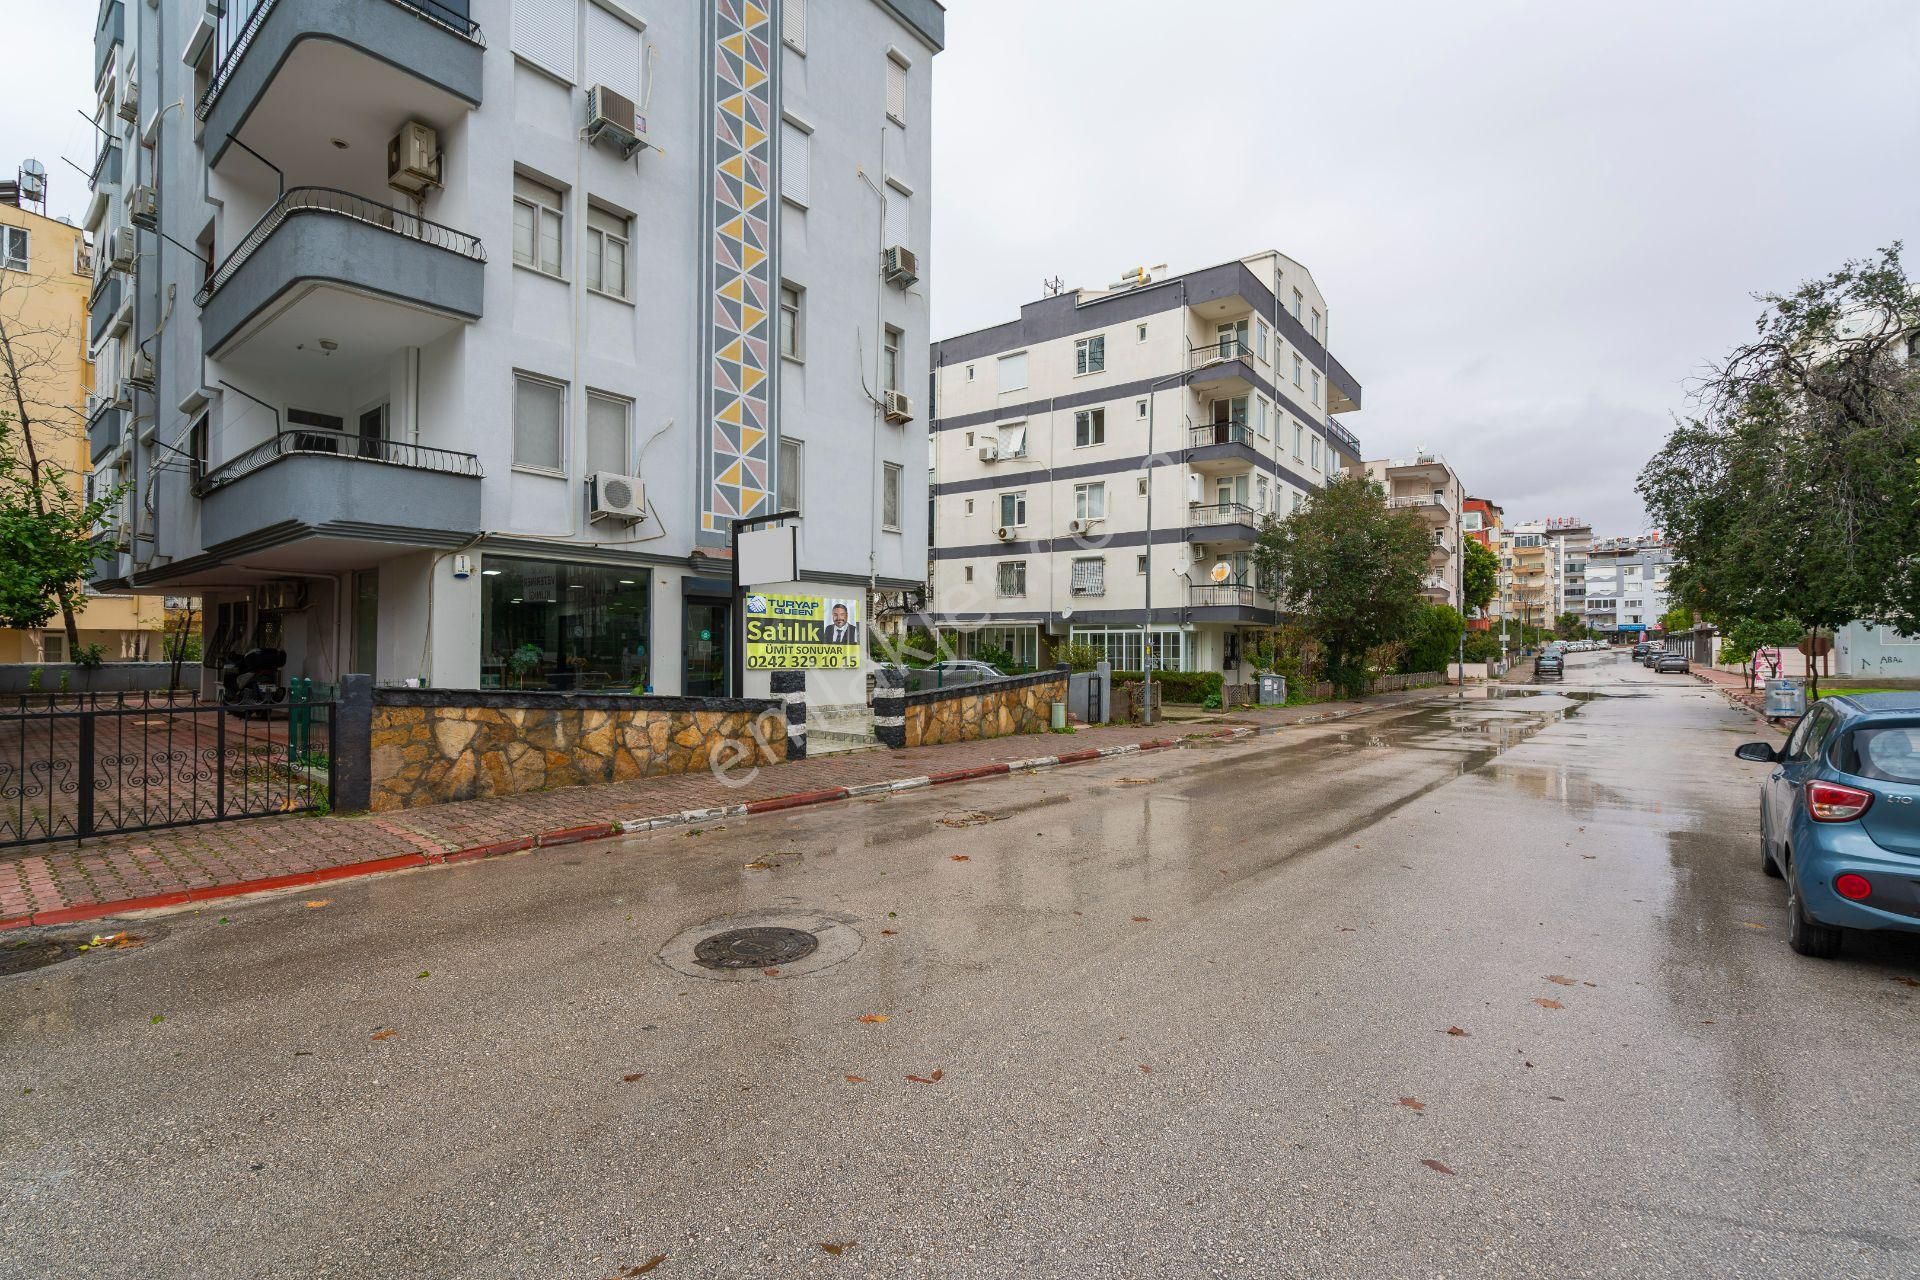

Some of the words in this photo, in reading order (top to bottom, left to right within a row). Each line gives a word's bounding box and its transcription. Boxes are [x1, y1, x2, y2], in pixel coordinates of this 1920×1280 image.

[768, 599, 819, 609] TURYAP
[774, 608, 814, 616] QUEEN
[747, 620, 820, 641] Satılık
[765, 643, 794, 654] ÜMİT
[796, 646, 843, 655] SONUVAR
[747, 655, 786, 667] 0242
[791, 656, 817, 667] 329
[822, 656, 837, 667] 10
[842, 656, 857, 667] 15
